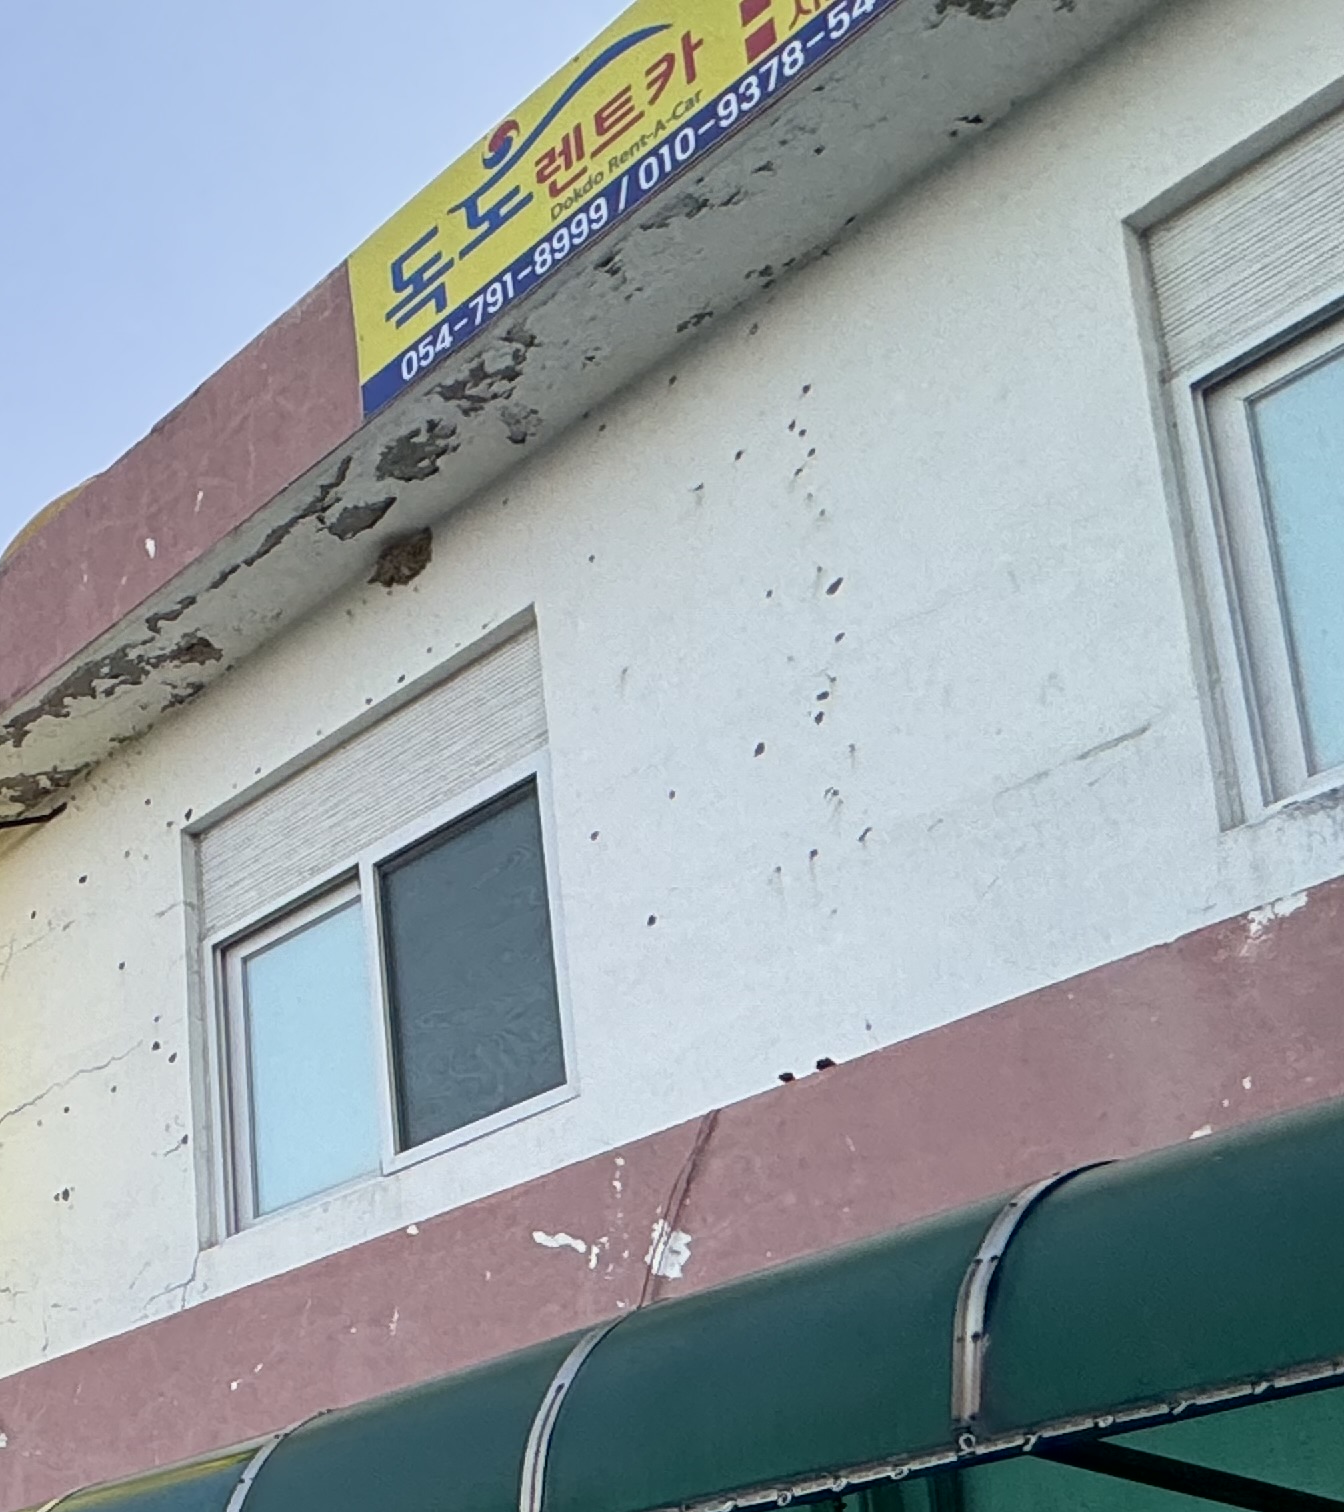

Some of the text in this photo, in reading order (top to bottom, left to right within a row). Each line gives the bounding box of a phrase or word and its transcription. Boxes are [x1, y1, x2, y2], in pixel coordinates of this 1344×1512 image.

[550, 88, 704, 220] Dokdo Rent-A-Car
[399, 194, 610, 380] 054-791-8999
